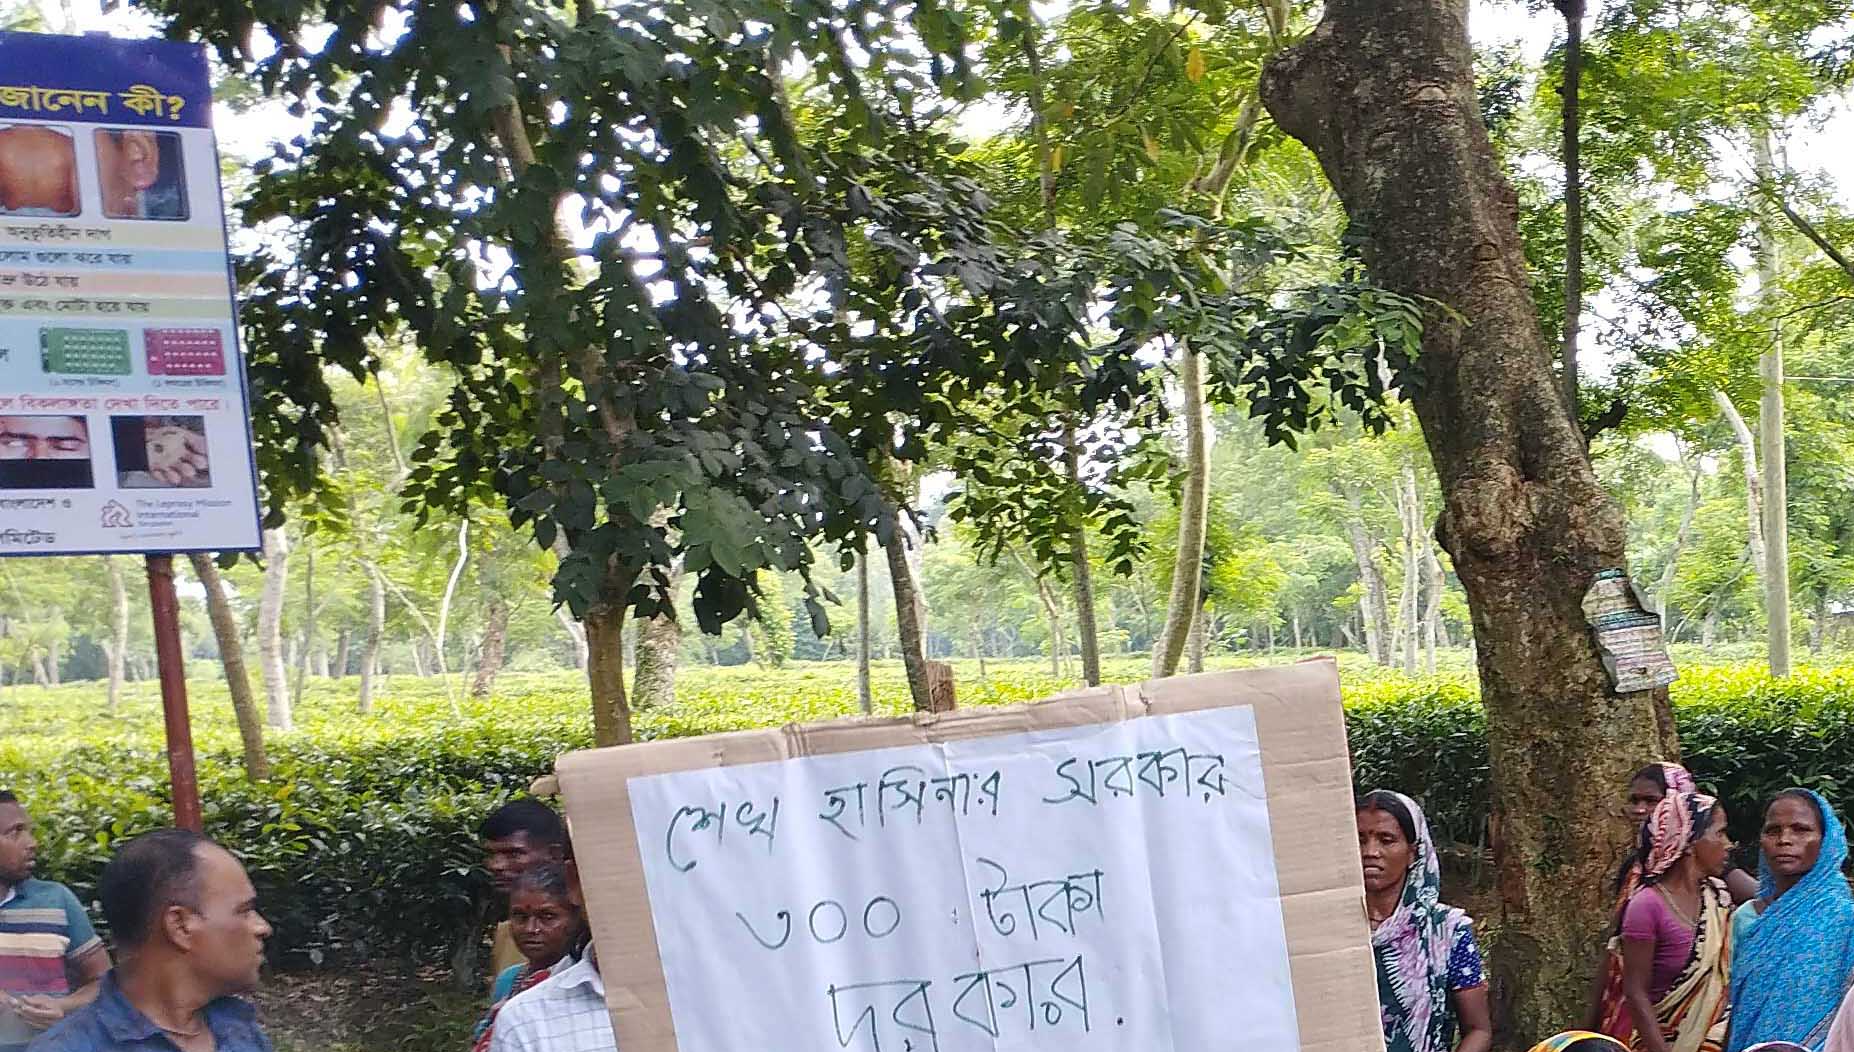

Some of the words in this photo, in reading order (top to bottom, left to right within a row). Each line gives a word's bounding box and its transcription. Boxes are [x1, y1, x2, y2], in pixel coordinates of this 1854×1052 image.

[118, 84, 186, 120] কী?
[666, 796, 780, 872] শেখ
[1041, 747, 1226, 805] সরকার
[735, 896, 901, 950] ৩০০
[976, 857, 1104, 941] টাকা
